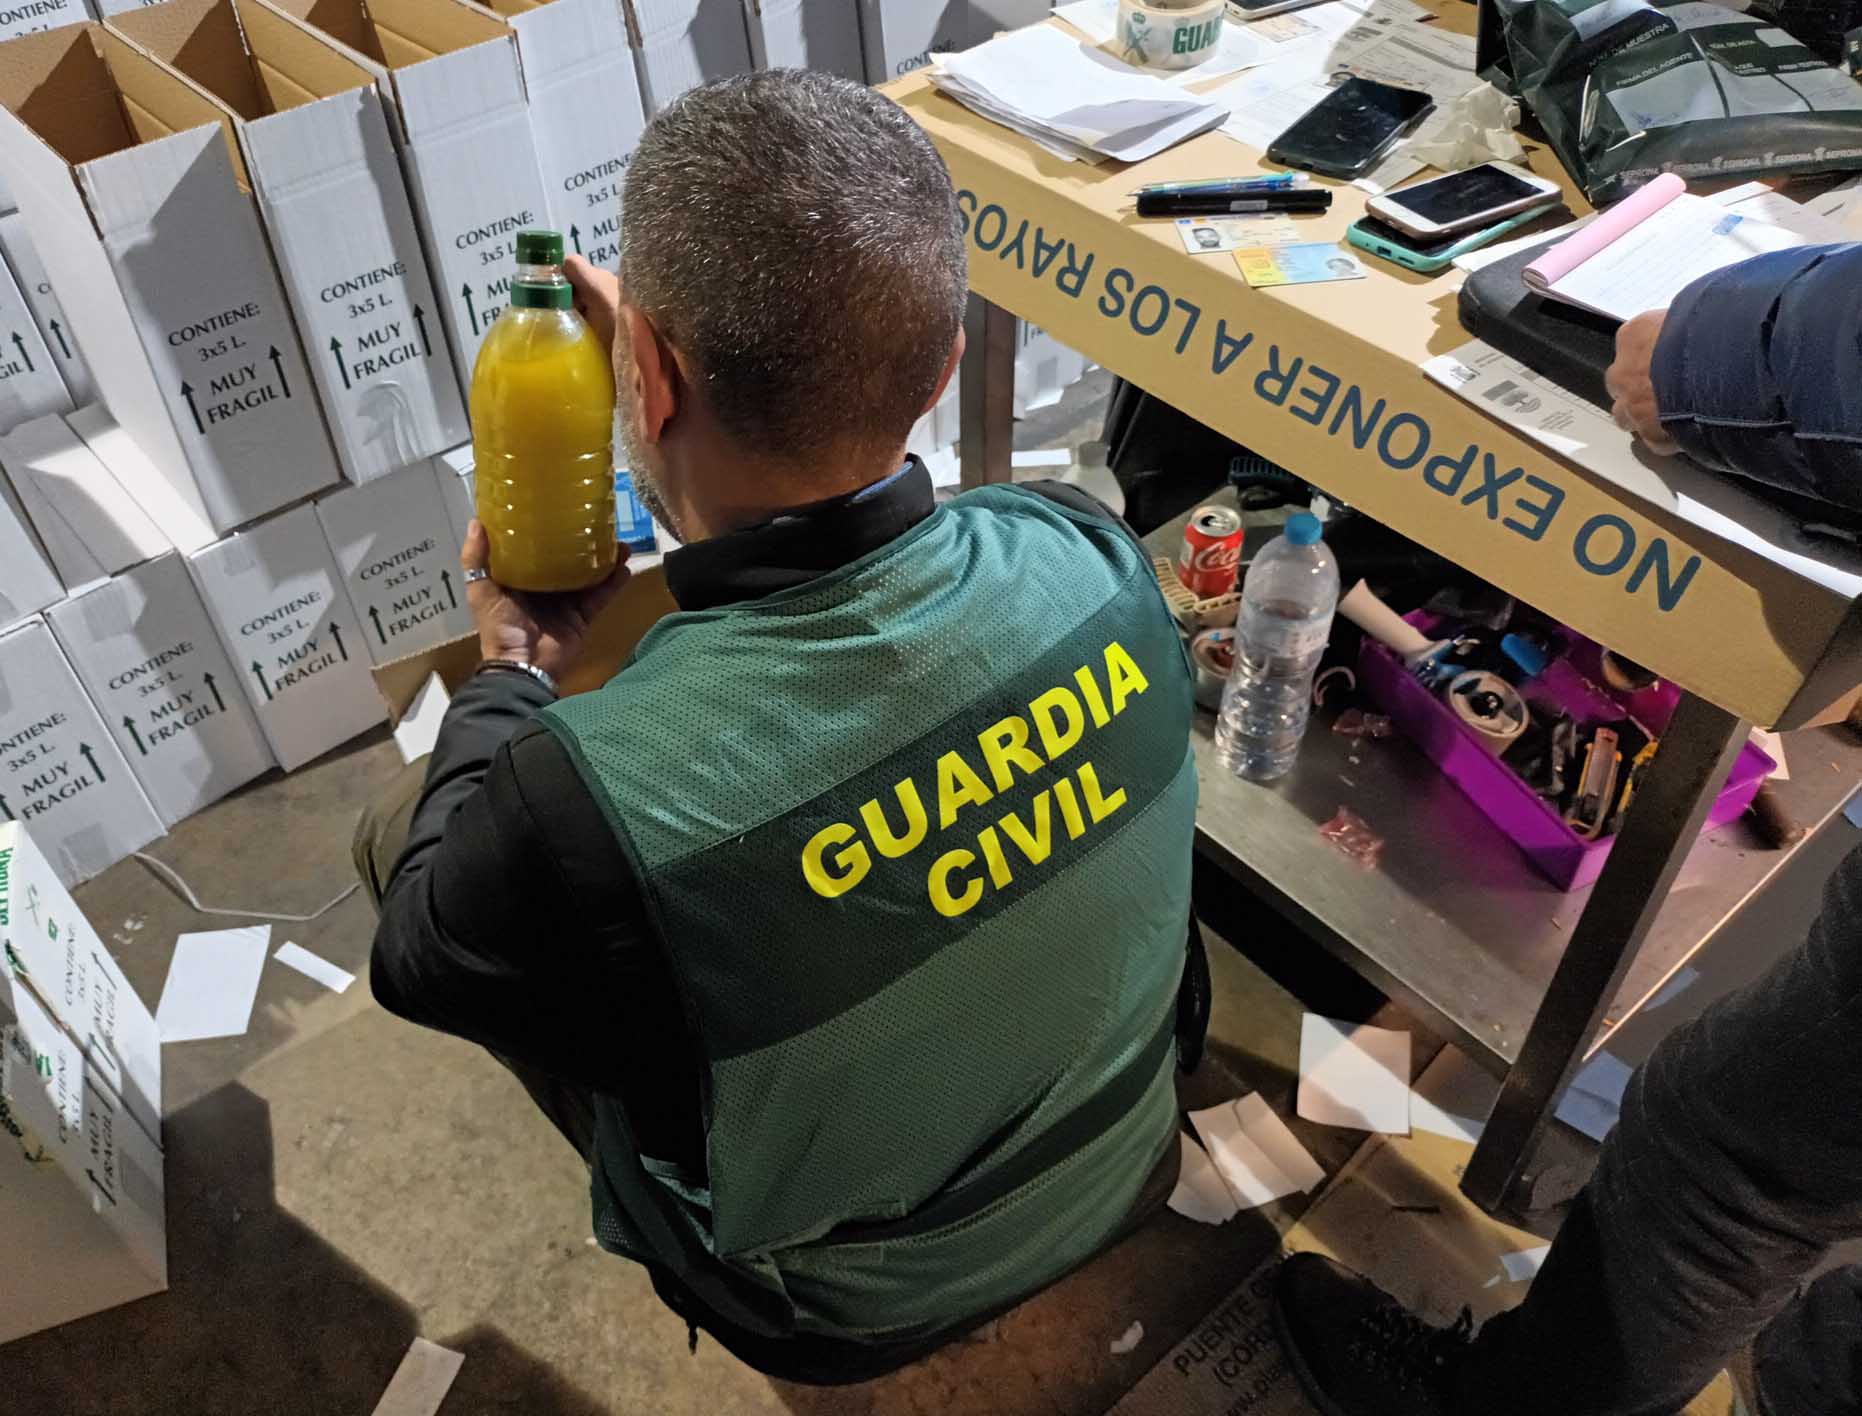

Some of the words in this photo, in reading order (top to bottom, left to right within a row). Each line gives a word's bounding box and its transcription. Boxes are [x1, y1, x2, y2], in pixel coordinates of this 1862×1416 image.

[0, 0, 67, 25] ONTIENE:
[563, 153, 632, 191] CONTIENE
[585, 188, 609, 207] 3x5
[612, 184, 620, 196] L
[456, 211, 534, 249] CONTIENE:
[592, 219, 621, 240] MU
[479, 245, 505, 266] 3x5
[507, 242, 517, 254] L
[588, 243, 622, 266] FRA
[320, 260, 407, 303] CONTIENE:
[487, 277, 511, 300] MU
[348, 298, 375, 319] 3x5
[379, 293, 393, 307] L.
[1098, 268, 1201, 354] LOS
[168, 302, 261, 347] CONTIENE:
[357, 321, 401, 352] MUY
[198, 338, 228, 363] 3x5
[232, 335, 247, 351] L.
[353, 343, 421, 380] FRAGIL
[1211, 319, 1254, 375] A
[0, 361, 22, 379] GIL
[209, 363, 257, 396] MUY
[207, 385, 279, 424] FRAGIL
[1254, 345, 1566, 541] EXPONER
[360, 538, 436, 581] CONTIENE:
[1573, 514, 1701, 612] NO
[384, 571, 409, 590] 3x5
[240, 590, 322, 637] CONTIENE:
[392, 585, 433, 614] MUY
[267, 625, 293, 645] 3x5
[388, 600, 449, 636] FRAGIL
[108, 640, 194, 690] CONTIENE:
[277, 637, 321, 669] MUY
[137, 677, 166, 698] 3x5
[275, 652, 338, 691] FRAGIL
[150, 690, 195, 722] MUY
[0, 711, 67, 755] NTIENE:
[148, 704, 216, 746] FRAGIL
[7, 750, 37, 772] 3x5
[22, 761, 70, 797] MUY
[802, 641, 1149, 898] GUARDIA
[22, 775, 94, 820] FRAGIL
[928, 761, 1127, 917] CIVIL
